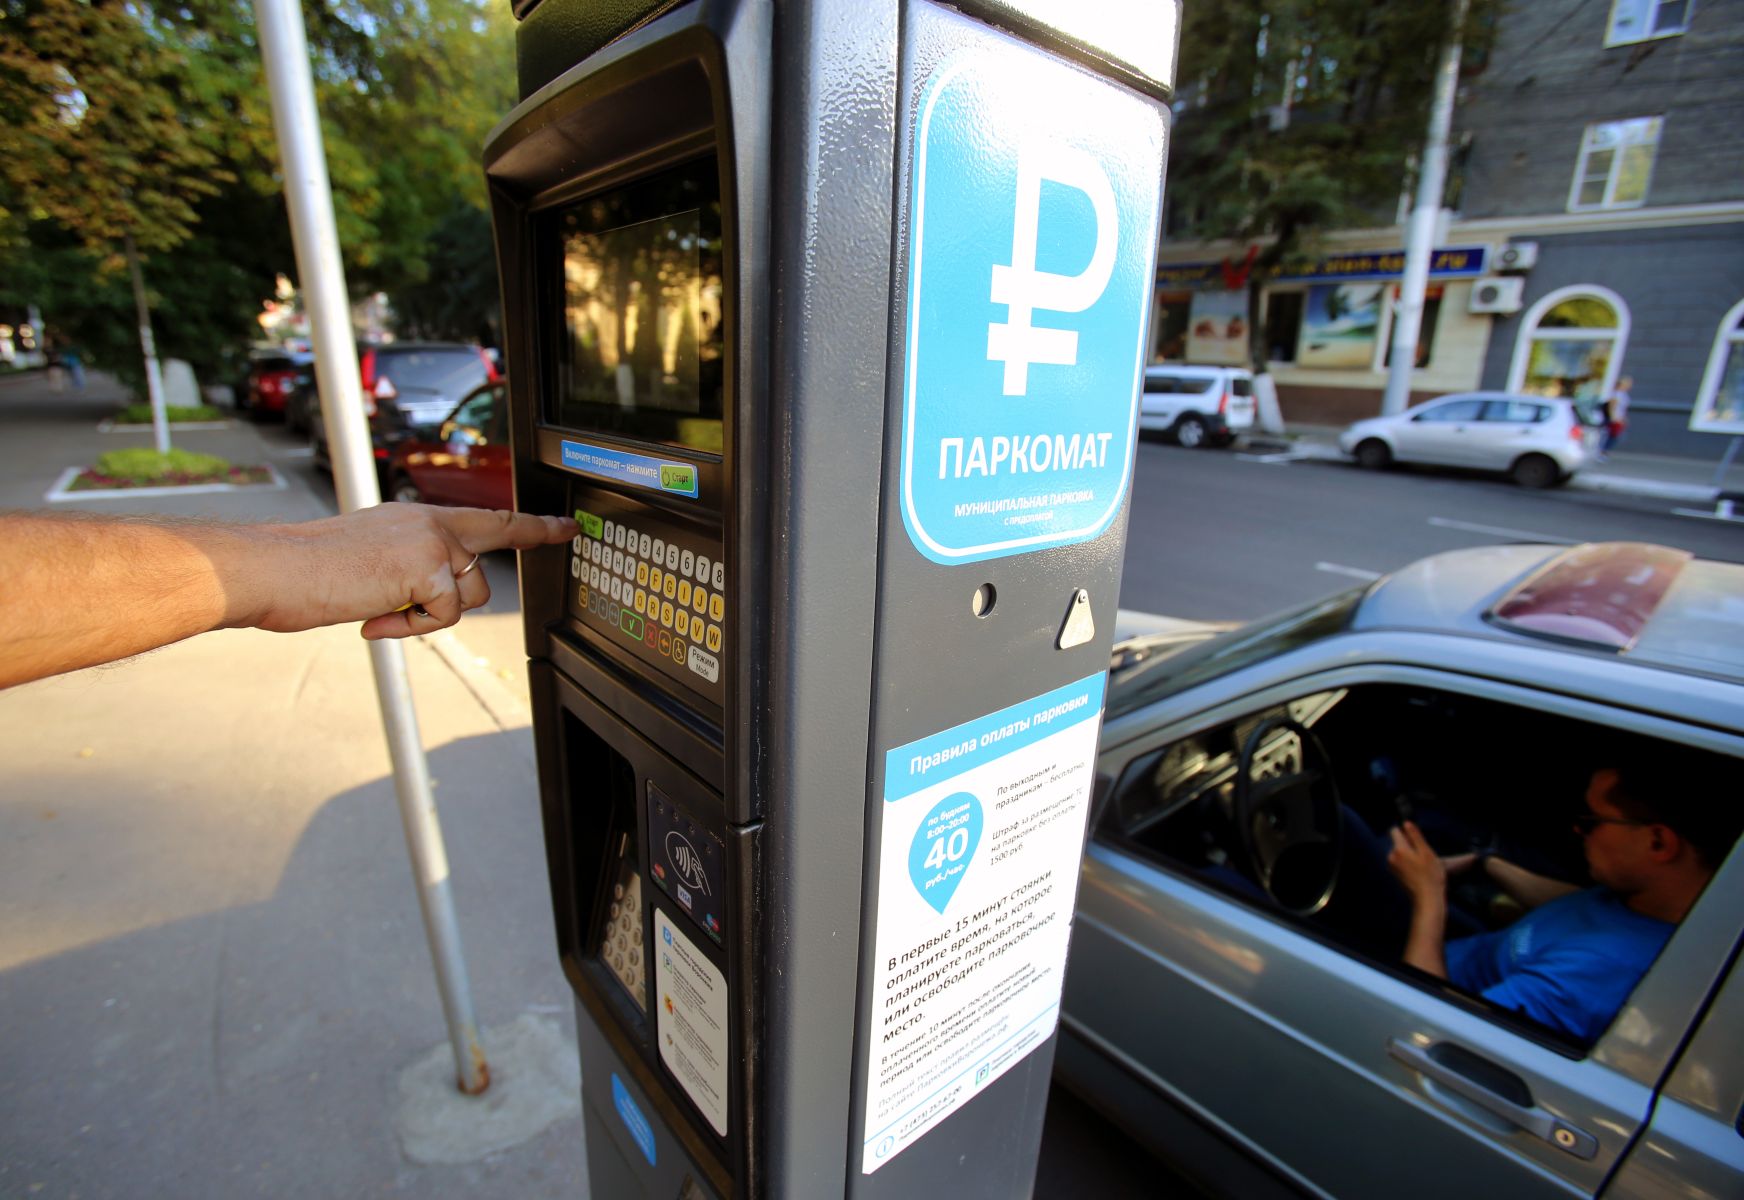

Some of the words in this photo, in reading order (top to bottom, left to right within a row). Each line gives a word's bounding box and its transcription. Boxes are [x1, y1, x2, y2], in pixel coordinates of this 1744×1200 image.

[565, 448, 591, 463] Включите
[592, 456, 620, 471] паркомат
[626, 463, 658, 478] нажмите
[672, 472, 688, 484] Старт
[939, 433, 1112, 479] ПАРКОМАТ
[954, 494, 1049, 517] МУНИЦИПАЛЬНАЯ
[1049, 489, 1094, 506] ПАРКОВКА
[693, 649, 715, 669] Режим
[696, 664, 709, 678] Mode
[909, 738, 976, 775] Правила
[980, 717, 1030, 746] оплаты
[1033, 694, 1088, 724] парковки
[995, 782, 1042, 809] праздникам
[997, 786, 1007, 795] По
[1010, 767, 1050, 789] выходным
[928, 817, 939, 827] по
[991, 844, 1000, 852] на
[1002, 824, 1037, 846] парковке
[1038, 817, 1050, 826] без
[992, 821, 1019, 839] Штраф
[923, 827, 969, 869] 40
[990, 851, 1007, 865] 1500
[887, 947, 946, 989] оплатите
[951, 922, 991, 952] время,
[995, 912, 1007, 924] на
[1011, 884, 1052, 915] которое
[888, 958, 895, 970] В
[901, 928, 950, 963] первые
[955, 917, 968, 932] 15
[972, 896, 1007, 922] минут
[1010, 869, 1051, 899] стоянки
[884, 1004, 909, 1026] или
[914, 956, 984, 1007] освободите
[989, 911, 1055, 959] парковочное
[886, 956, 960, 1008] планируете
[965, 910, 1035, 959] парковаться,
[881, 1055, 887, 1065] В
[890, 1032, 925, 1059] течение
[929, 1023, 937, 1033] 10
[941, 1006, 965, 1025] минут
[968, 989, 990, 1007] после
[881, 1034, 938, 1076] оплаченного
[941, 1009, 975, 1036] времени
[883, 1010, 925, 1043] место.
[880, 1061, 913, 1087] период
[916, 1049, 931, 1063] или
[935, 1015, 980, 1050] освободите
